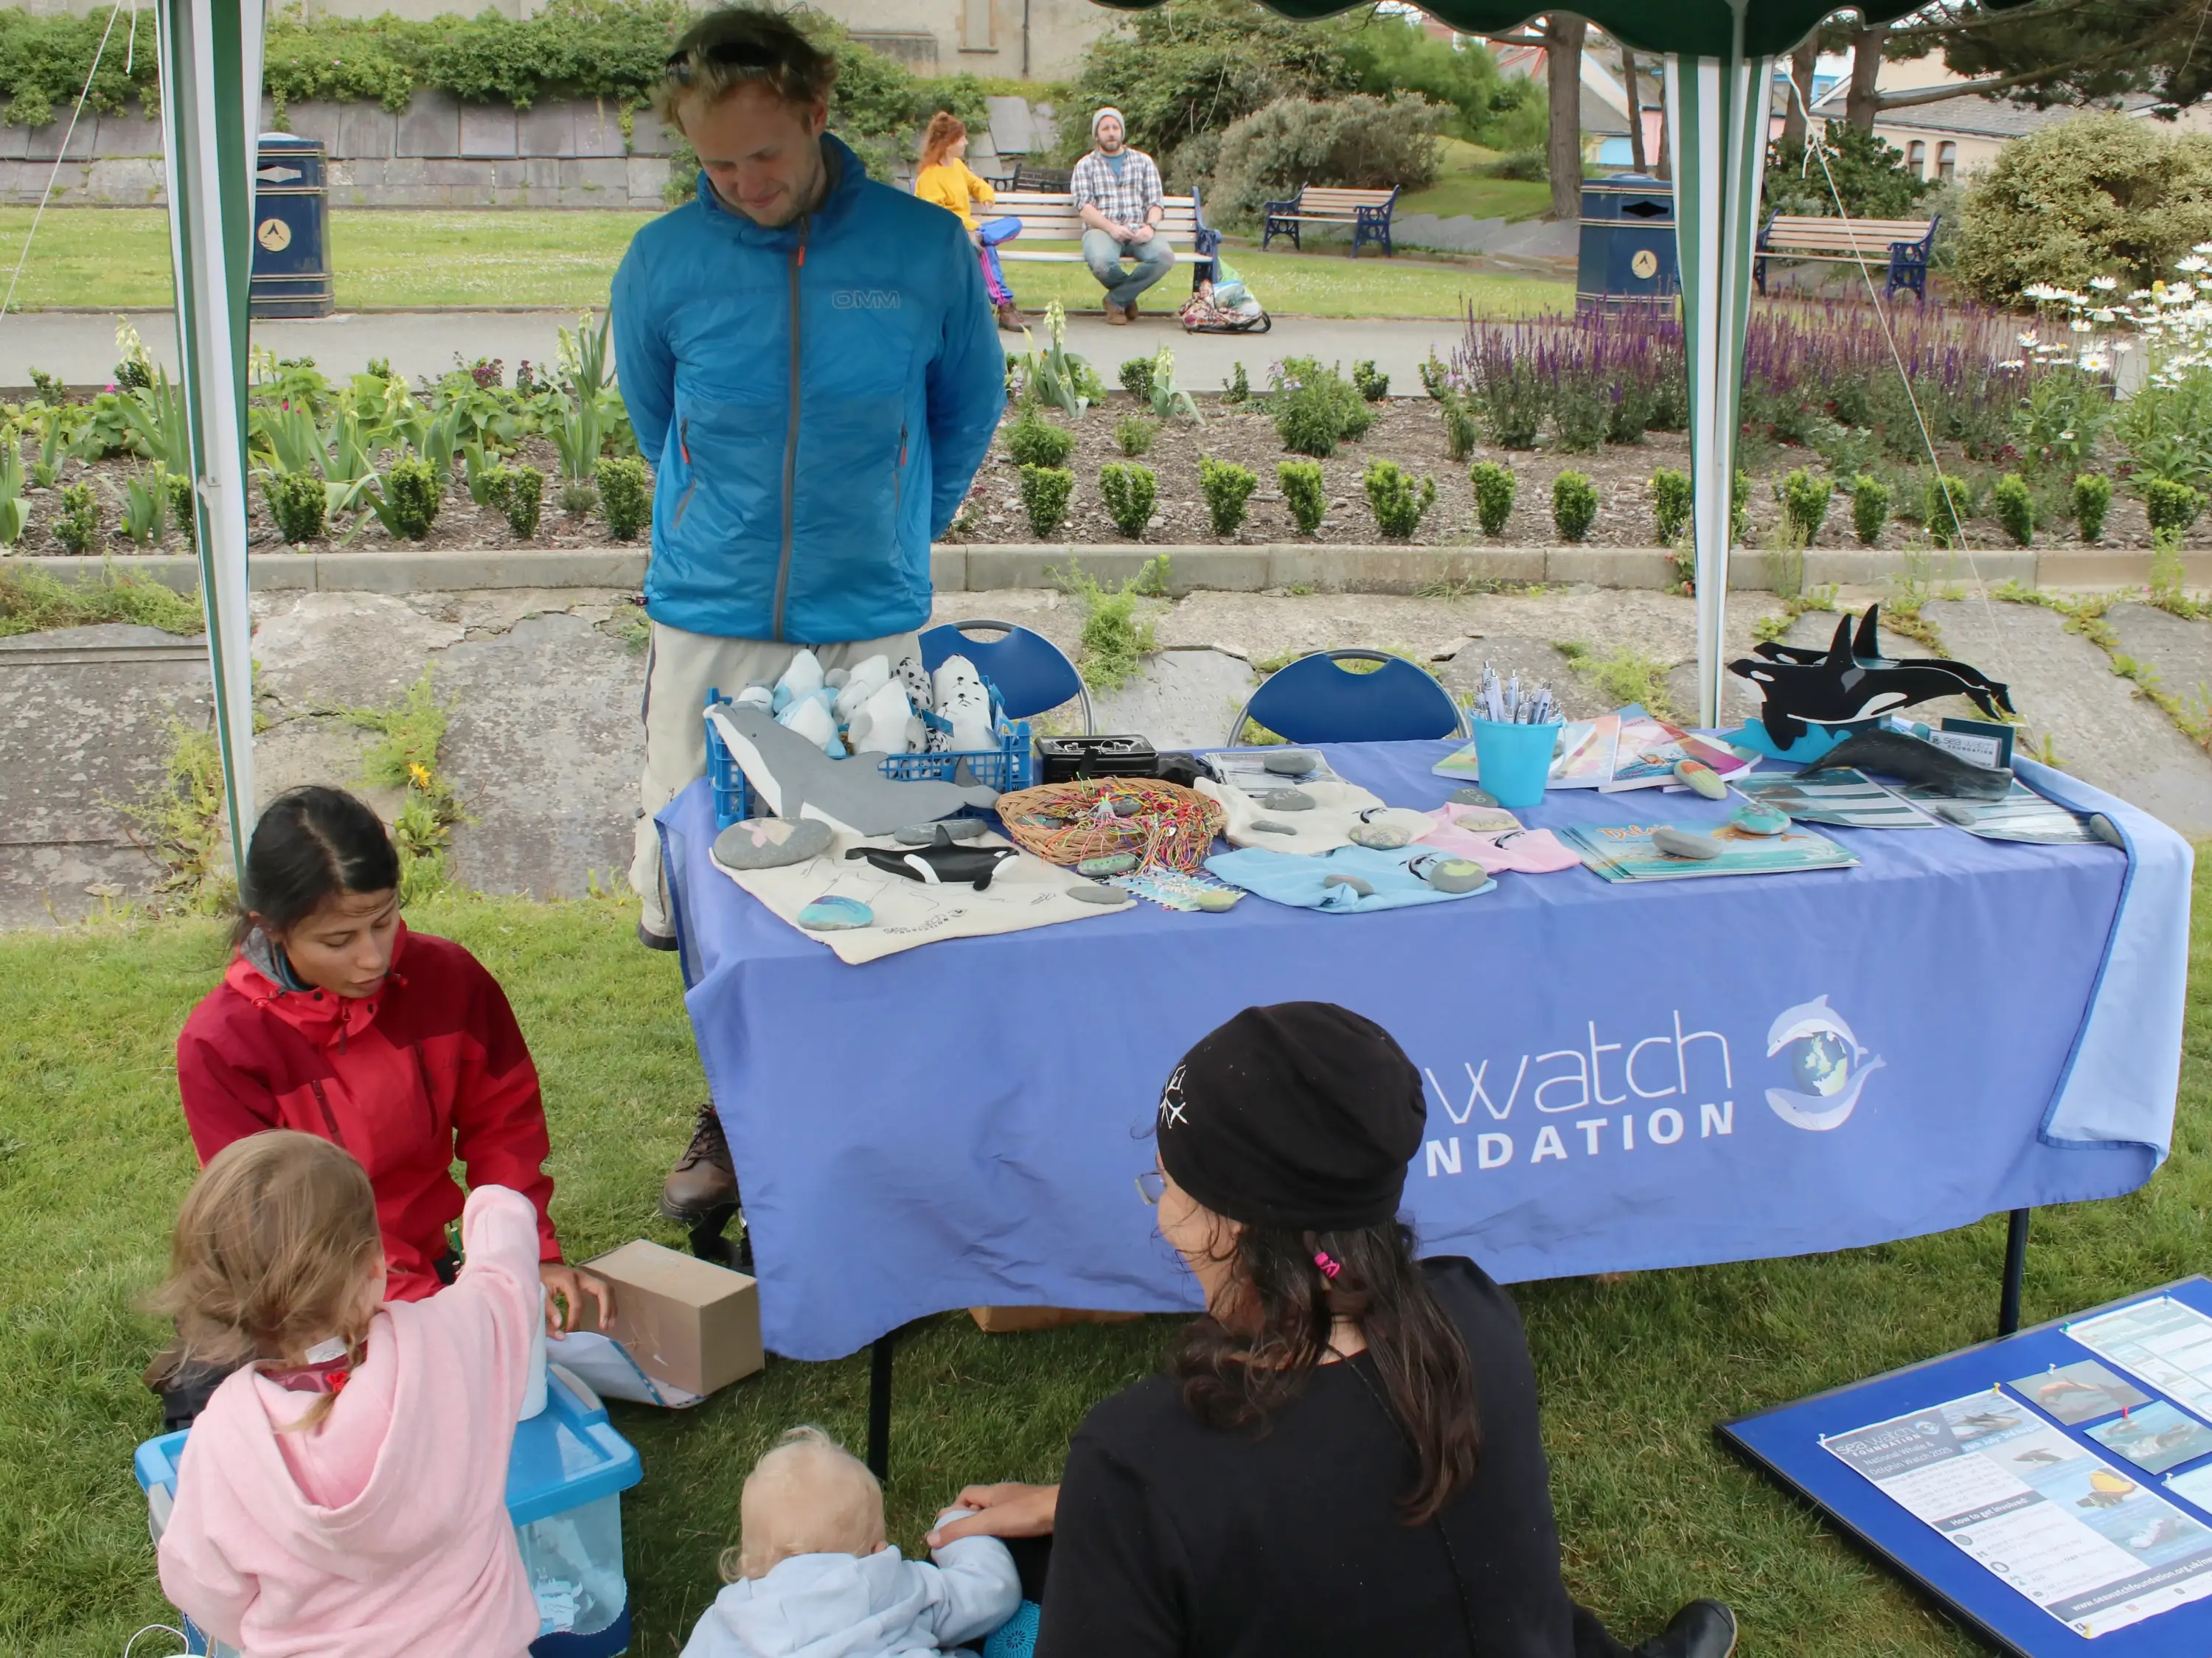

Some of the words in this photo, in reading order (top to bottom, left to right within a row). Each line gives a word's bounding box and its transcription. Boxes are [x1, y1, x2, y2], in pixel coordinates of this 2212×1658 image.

[832, 290, 900, 310] OMM
[1947, 744, 1994, 756] FOUNDATION
[1424, 1009, 1733, 1125] watch
[1426, 1101, 1734, 1177] NDATION
[1835, 1440, 1866, 1456] sea
[1865, 1425, 1915, 1448] watch
[1852, 1433, 1921, 1457] FOUNDATION
[1863, 1449, 1903, 1466] National
[1899, 1443, 1927, 1460] Whale
[1869, 1460, 1905, 1477] Dolphin
[1903, 1453, 1933, 1469] Watch
[1950, 1515, 1971, 1527] How
[1969, 1512, 1981, 1522] to
[1979, 1508, 1994, 1519] get
